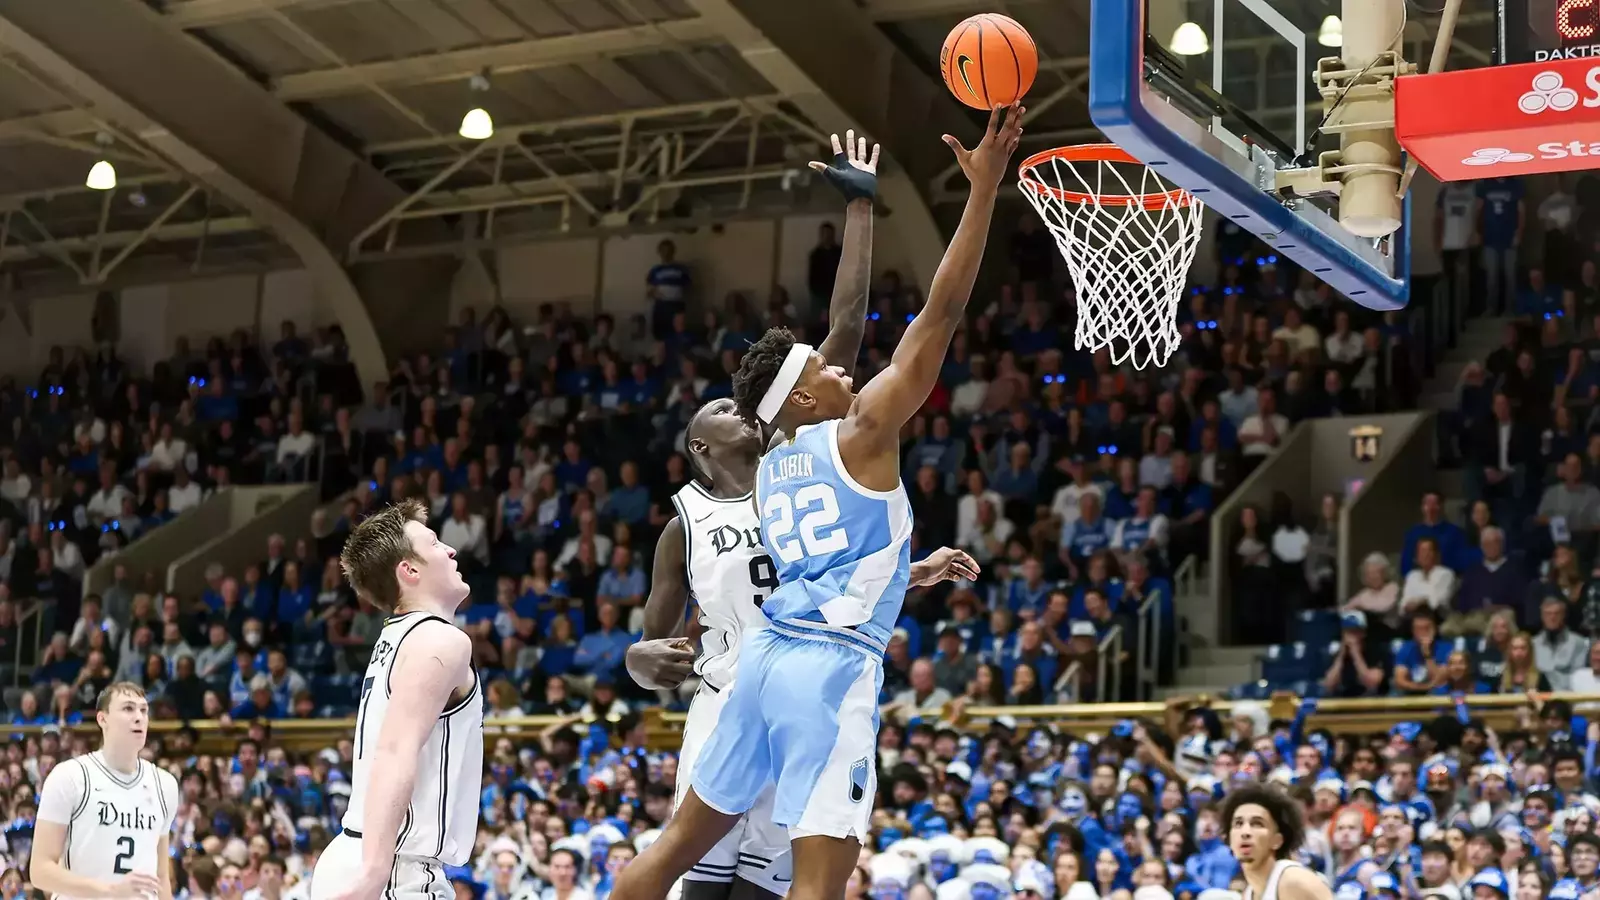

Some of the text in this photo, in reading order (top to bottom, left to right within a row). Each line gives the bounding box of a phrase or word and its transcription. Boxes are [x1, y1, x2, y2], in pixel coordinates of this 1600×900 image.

[768, 452, 814, 485] LUBIN
[763, 483, 850, 564] 22
[749, 554, 780, 609] 9
[97, 800, 157, 831] Duke
[113, 835, 135, 874] 2
